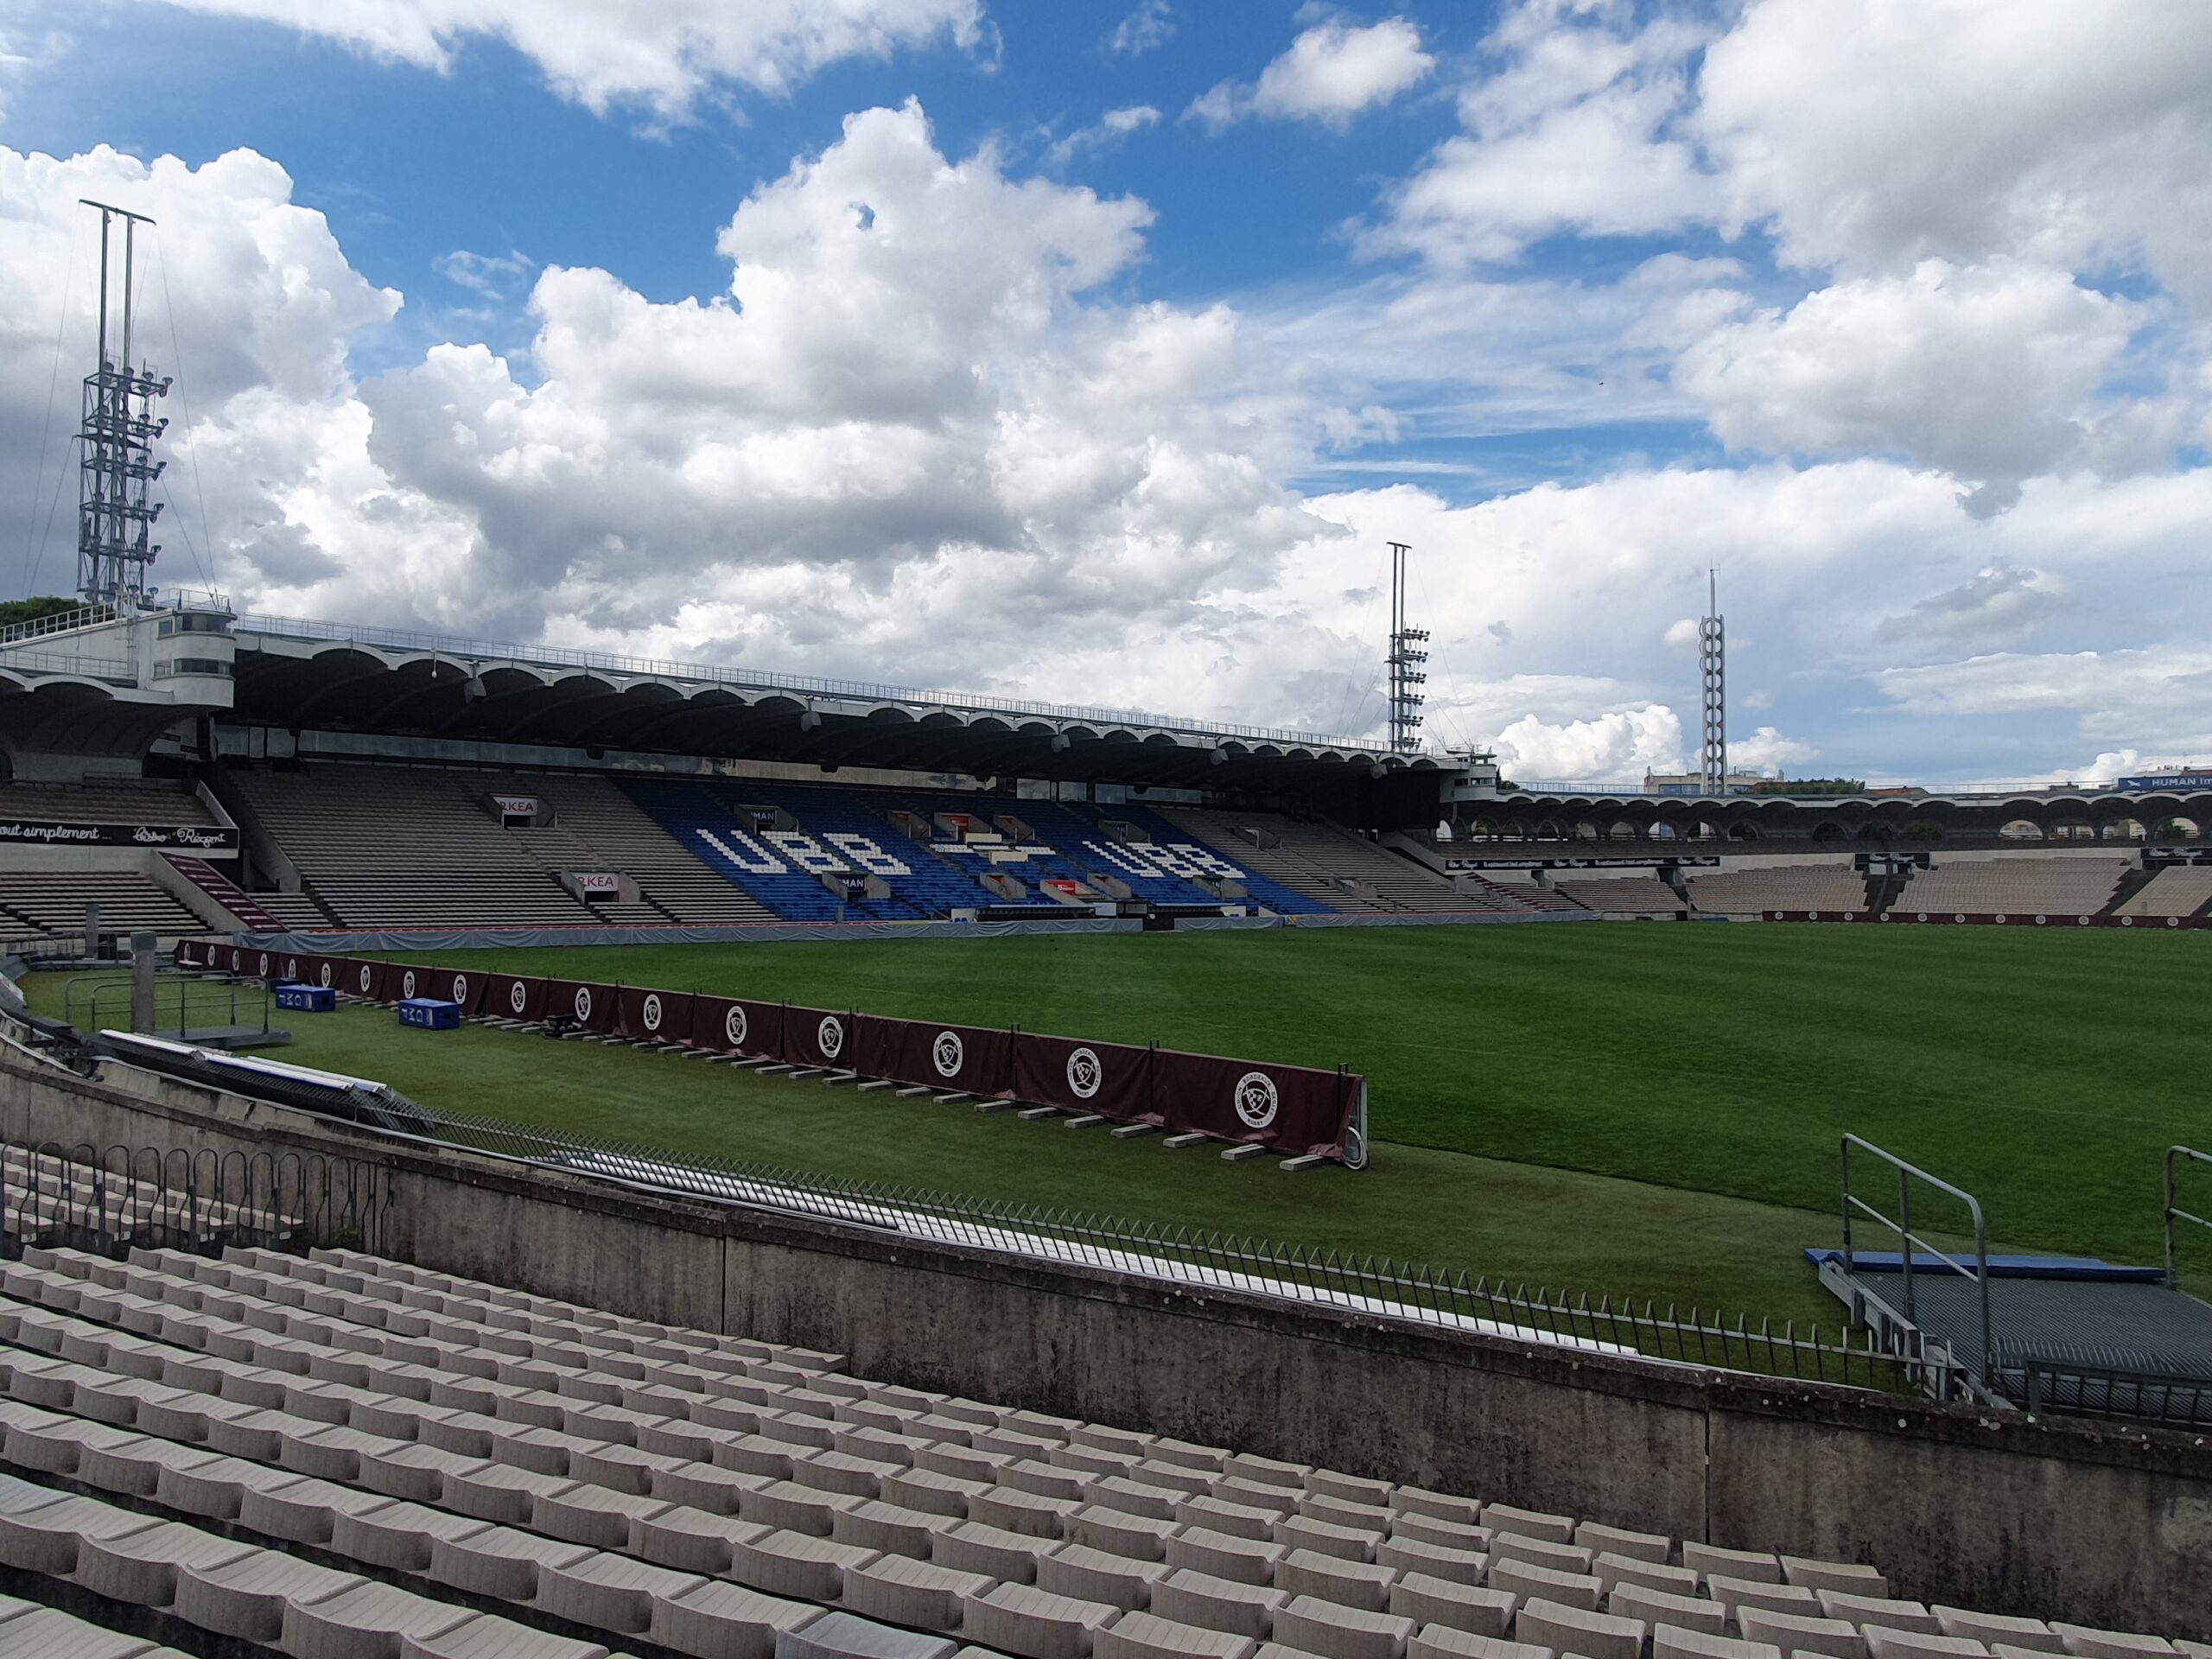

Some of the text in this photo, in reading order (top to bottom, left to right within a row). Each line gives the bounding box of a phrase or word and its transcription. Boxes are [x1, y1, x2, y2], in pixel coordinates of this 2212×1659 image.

[2152, 777, 2196, 787] HUMAN
[750, 811, 774, 821] MAN
[839, 878, 864, 887] MAN
